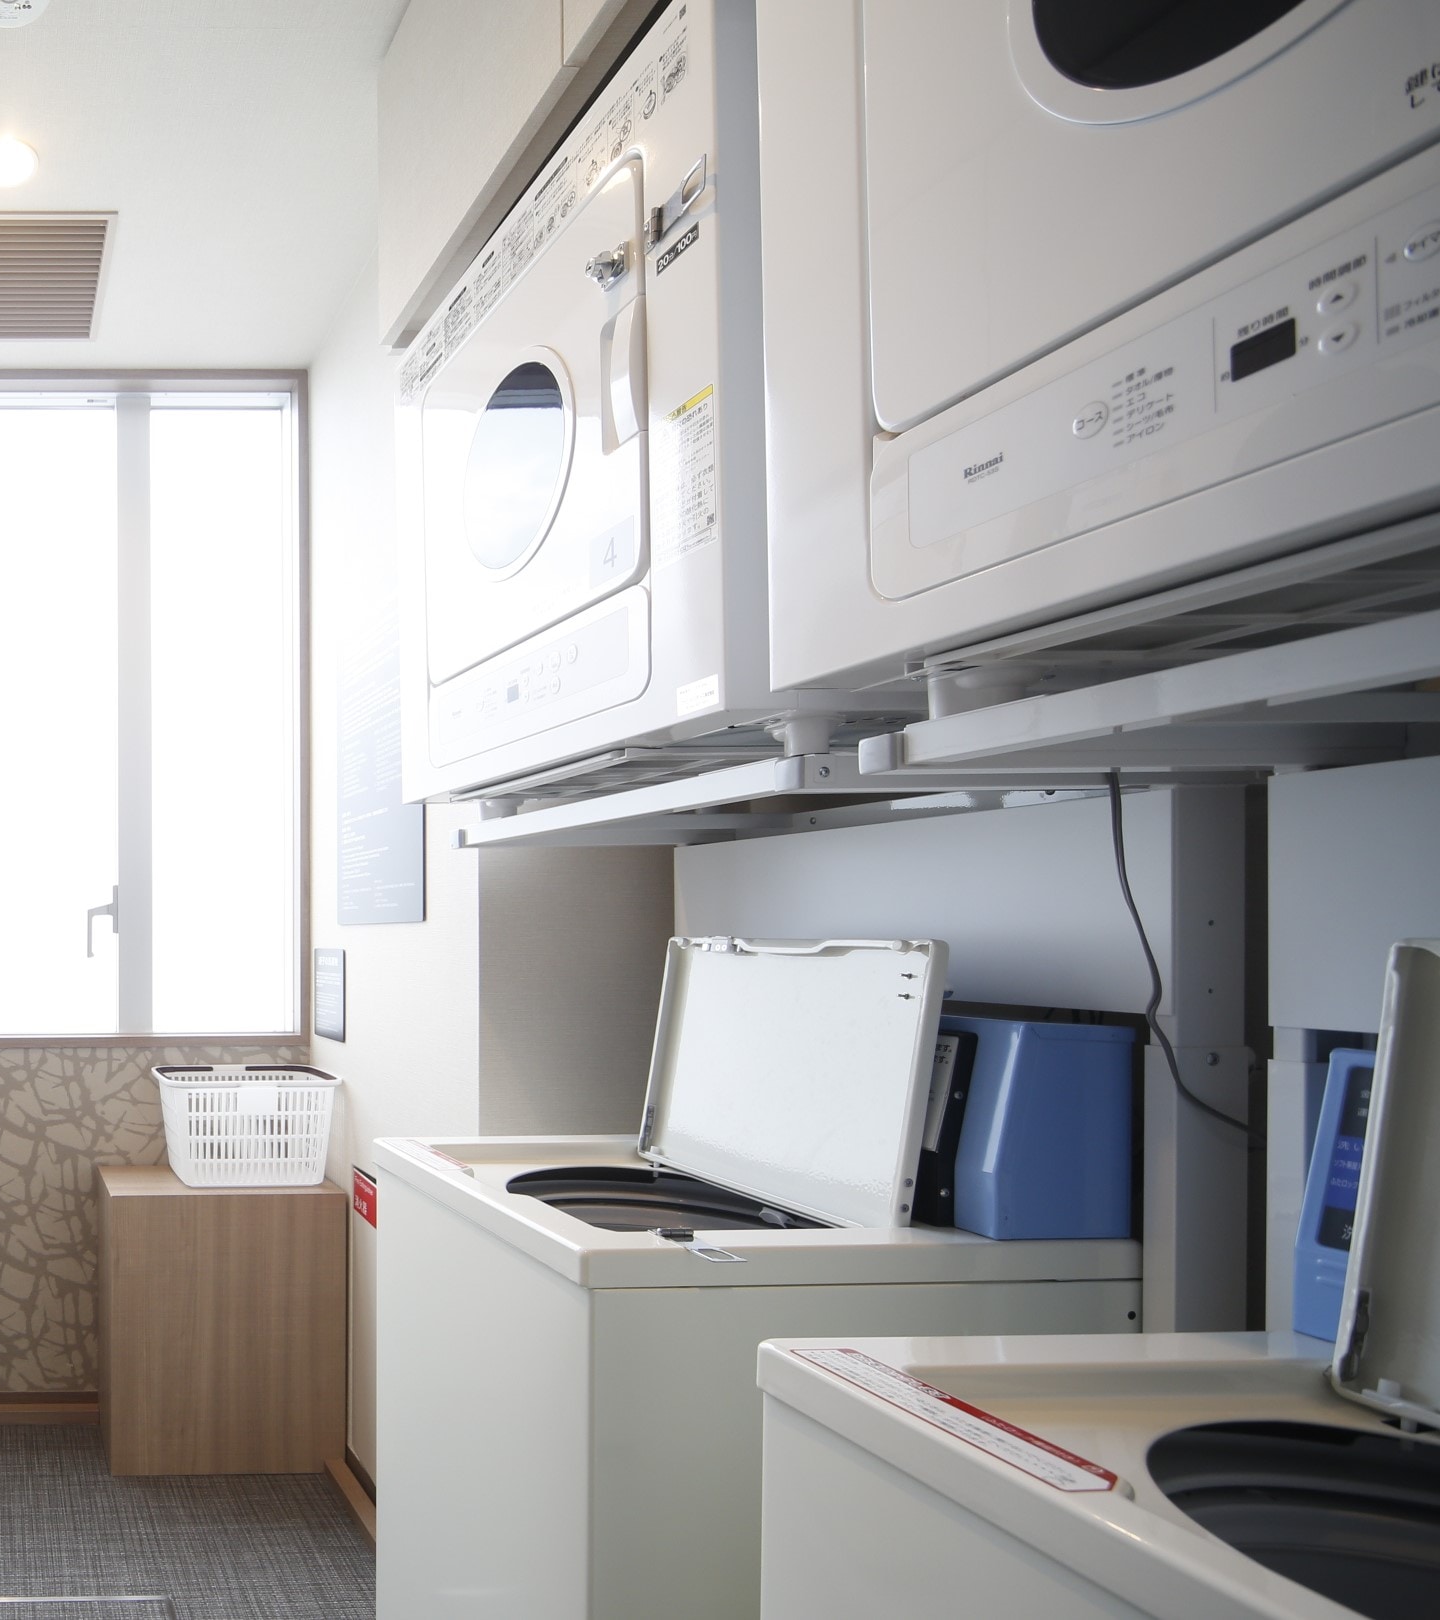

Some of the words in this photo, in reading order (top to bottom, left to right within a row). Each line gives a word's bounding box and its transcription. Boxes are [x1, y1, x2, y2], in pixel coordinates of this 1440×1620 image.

[1077, 410, 1103, 431] コース
[1126, 422, 1165, 444] アイロン
[963, 451, 1003, 480] Rinnai
[603, 537, 618, 568] 4
